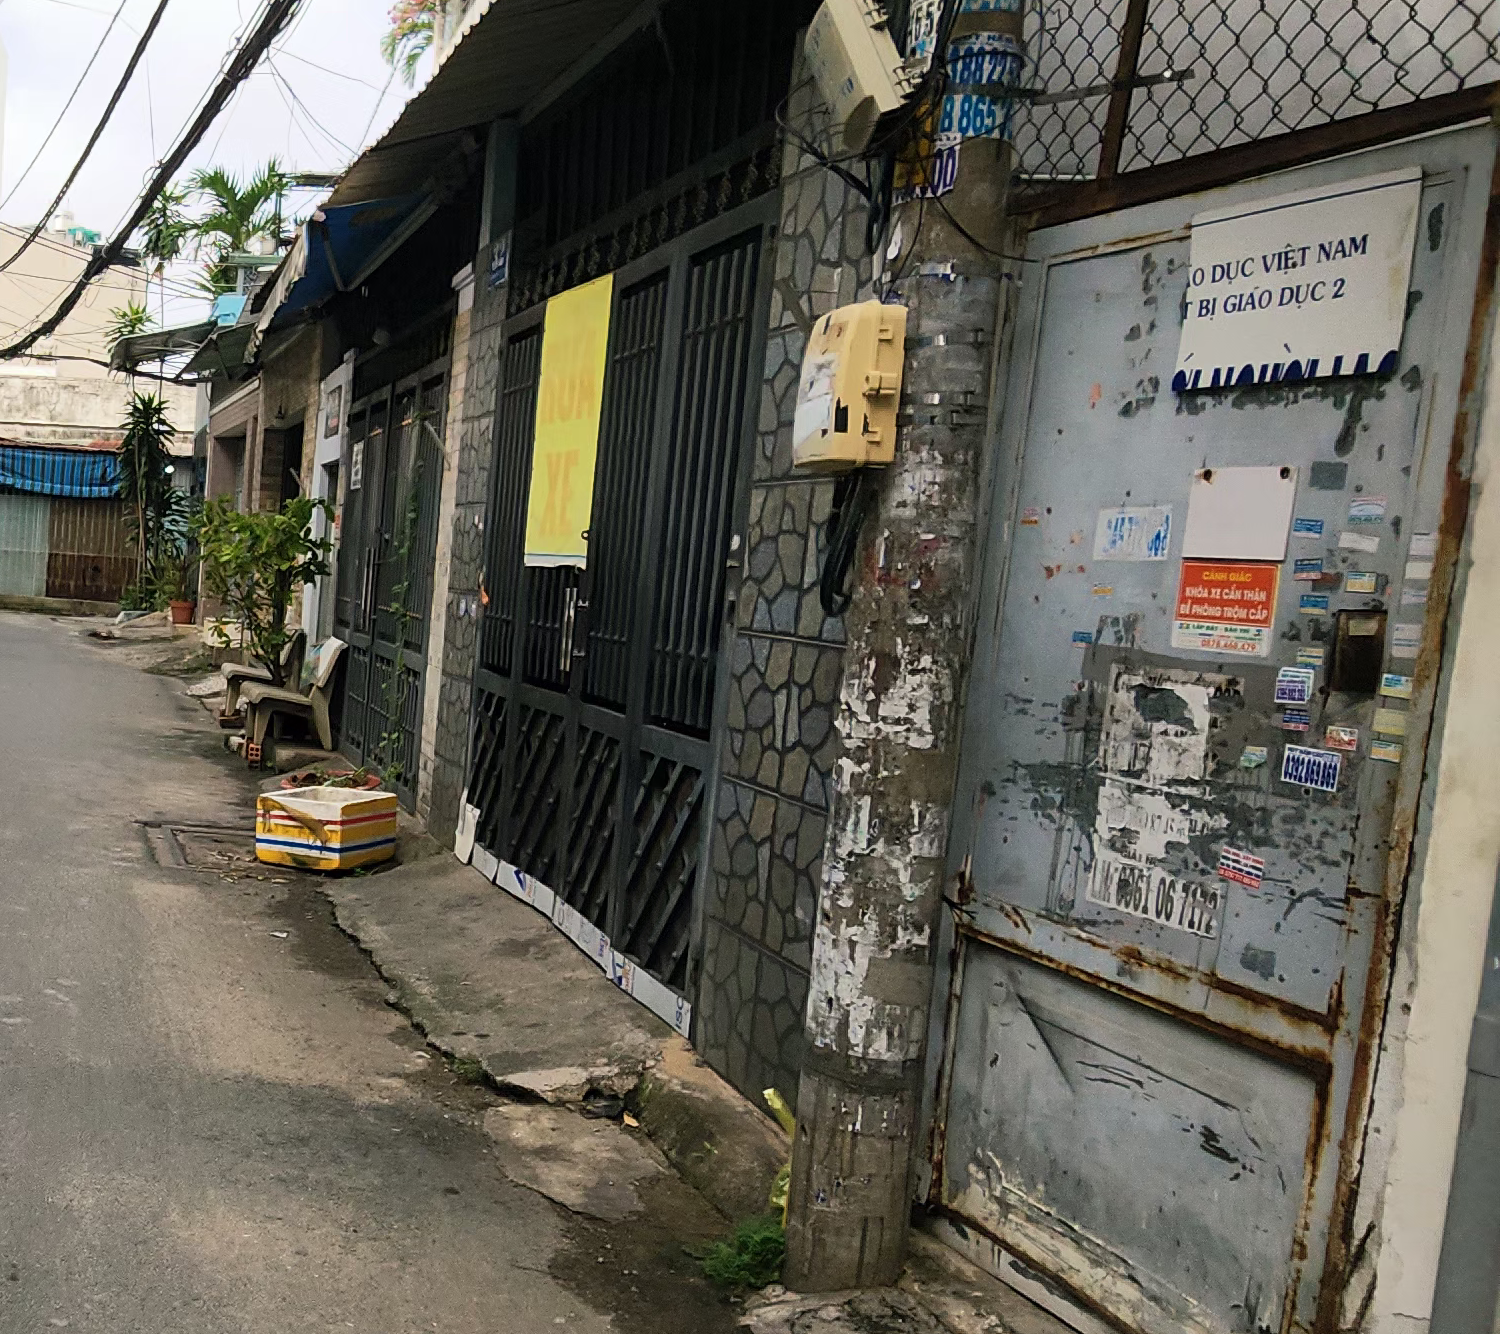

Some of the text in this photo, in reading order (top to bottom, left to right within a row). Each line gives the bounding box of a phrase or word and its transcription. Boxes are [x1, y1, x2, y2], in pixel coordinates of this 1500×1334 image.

[1187, 234, 1369, 288] O DỤC VIỆT NAM
[1197, 297, 1217, 321] BỊ
[1223, 285, 1273, 314] GIÁO
[1278, 280, 1326, 309] DỤC
[1332, 277, 1346, 299] 2
[1211, 586, 1221, 598] XE
